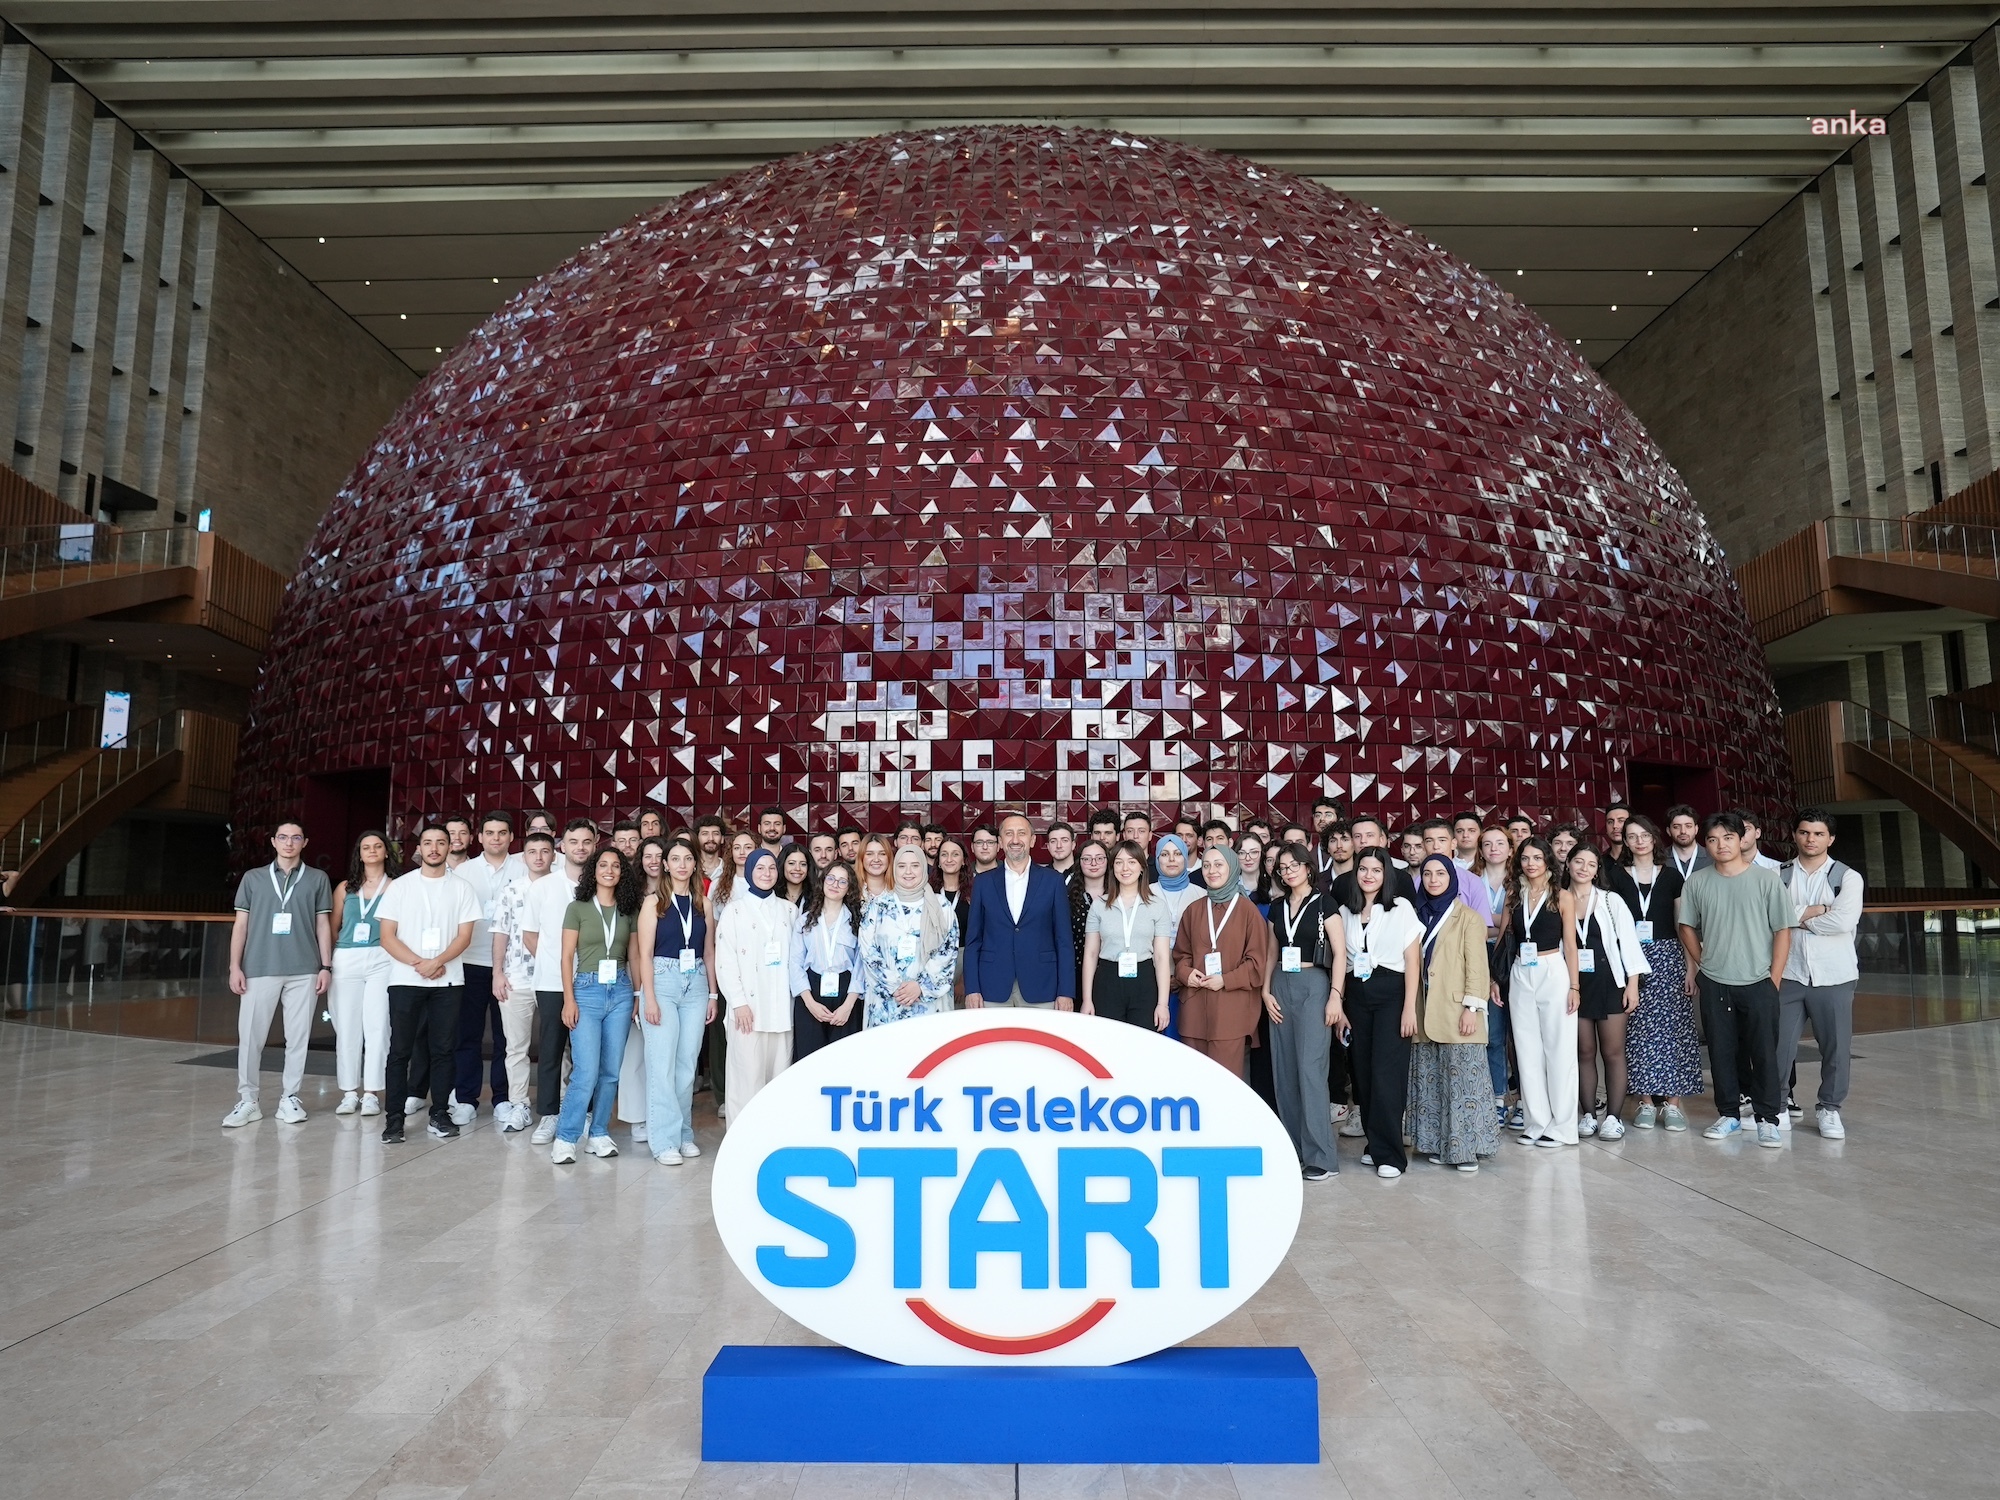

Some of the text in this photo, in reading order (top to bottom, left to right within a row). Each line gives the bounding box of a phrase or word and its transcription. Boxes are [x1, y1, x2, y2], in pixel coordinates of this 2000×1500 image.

[820, 1085, 1201, 1133] Türk Telekom
[755, 1146, 1264, 1290] START
